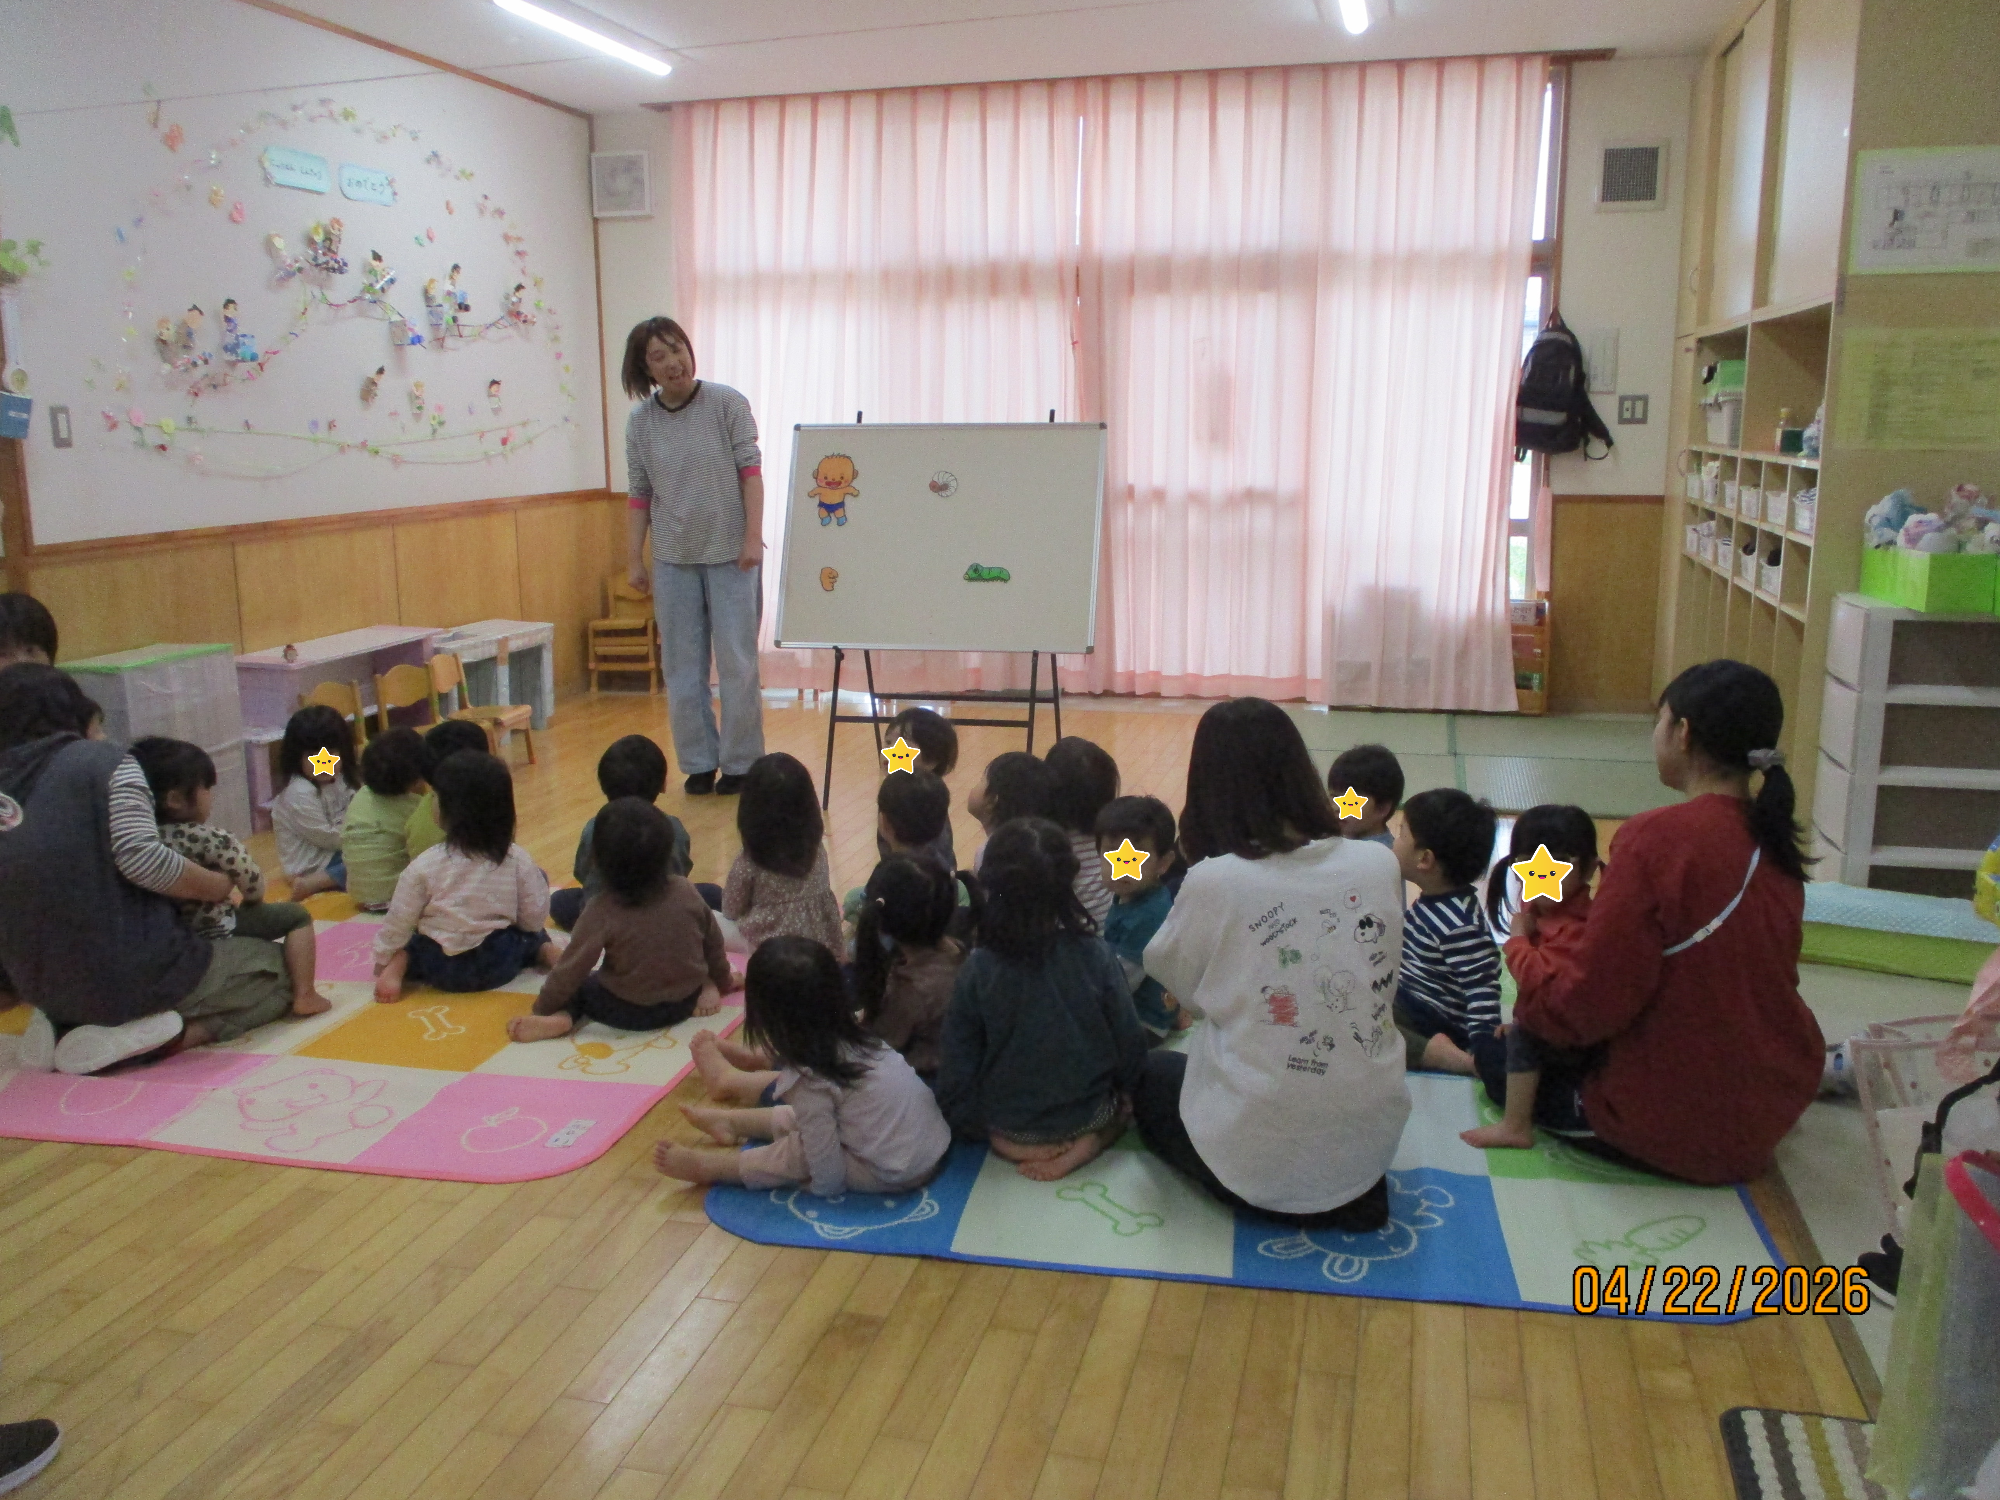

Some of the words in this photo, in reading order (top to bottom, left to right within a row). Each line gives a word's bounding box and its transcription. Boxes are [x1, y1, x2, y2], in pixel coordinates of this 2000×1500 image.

[1248, 901, 1285, 932] SNOOPY
[1260, 917, 1298, 947] WOODSTOCK
[1286, 1062, 1327, 1077] yesterday
[1288, 1054, 1309, 1065] Learn
[1311, 1059, 1329, 1069] from
